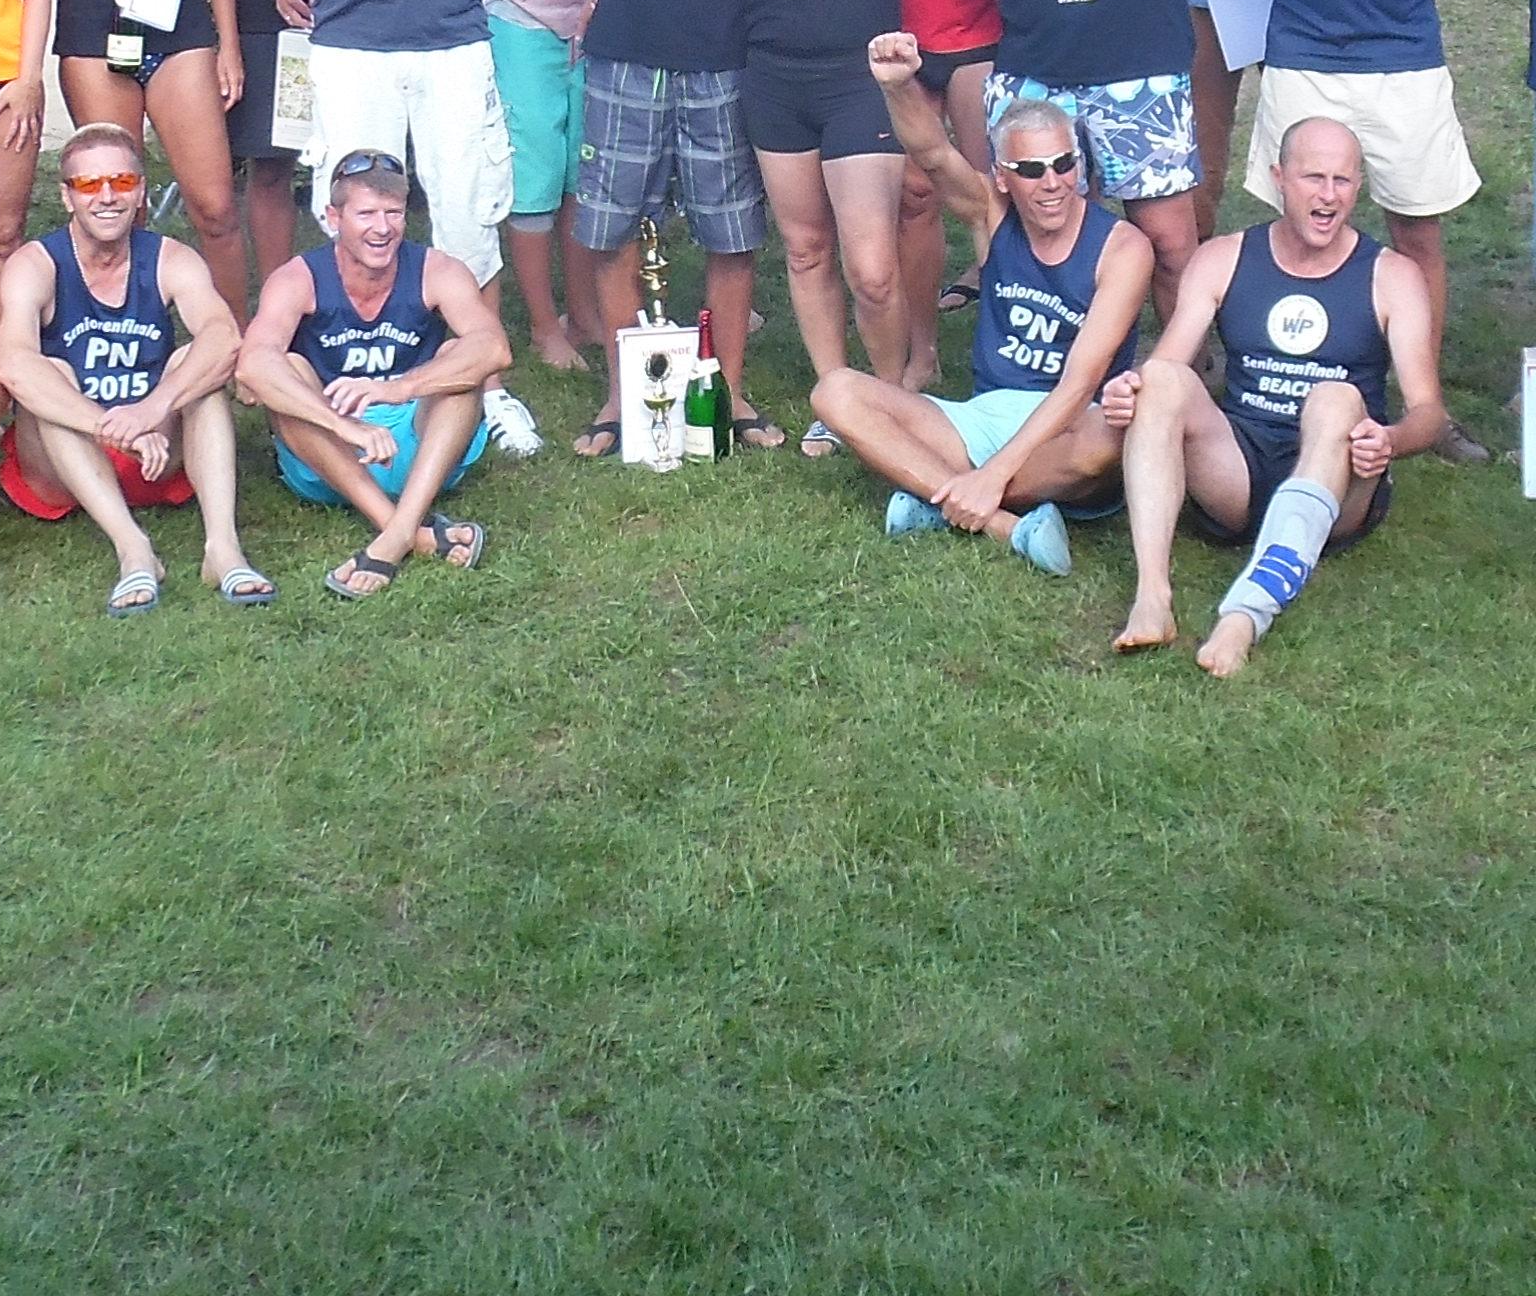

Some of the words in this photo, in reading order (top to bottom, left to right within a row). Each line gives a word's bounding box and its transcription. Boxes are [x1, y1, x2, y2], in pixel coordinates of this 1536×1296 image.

[1009, 304, 1061, 344] PN
[84, 336, 140, 370] PN
[341, 345, 396, 374] PN
[997, 335, 1064, 375] 2015
[1241, 355, 1350, 380] Seniorenfinale
[83, 371, 150, 402] 2015
